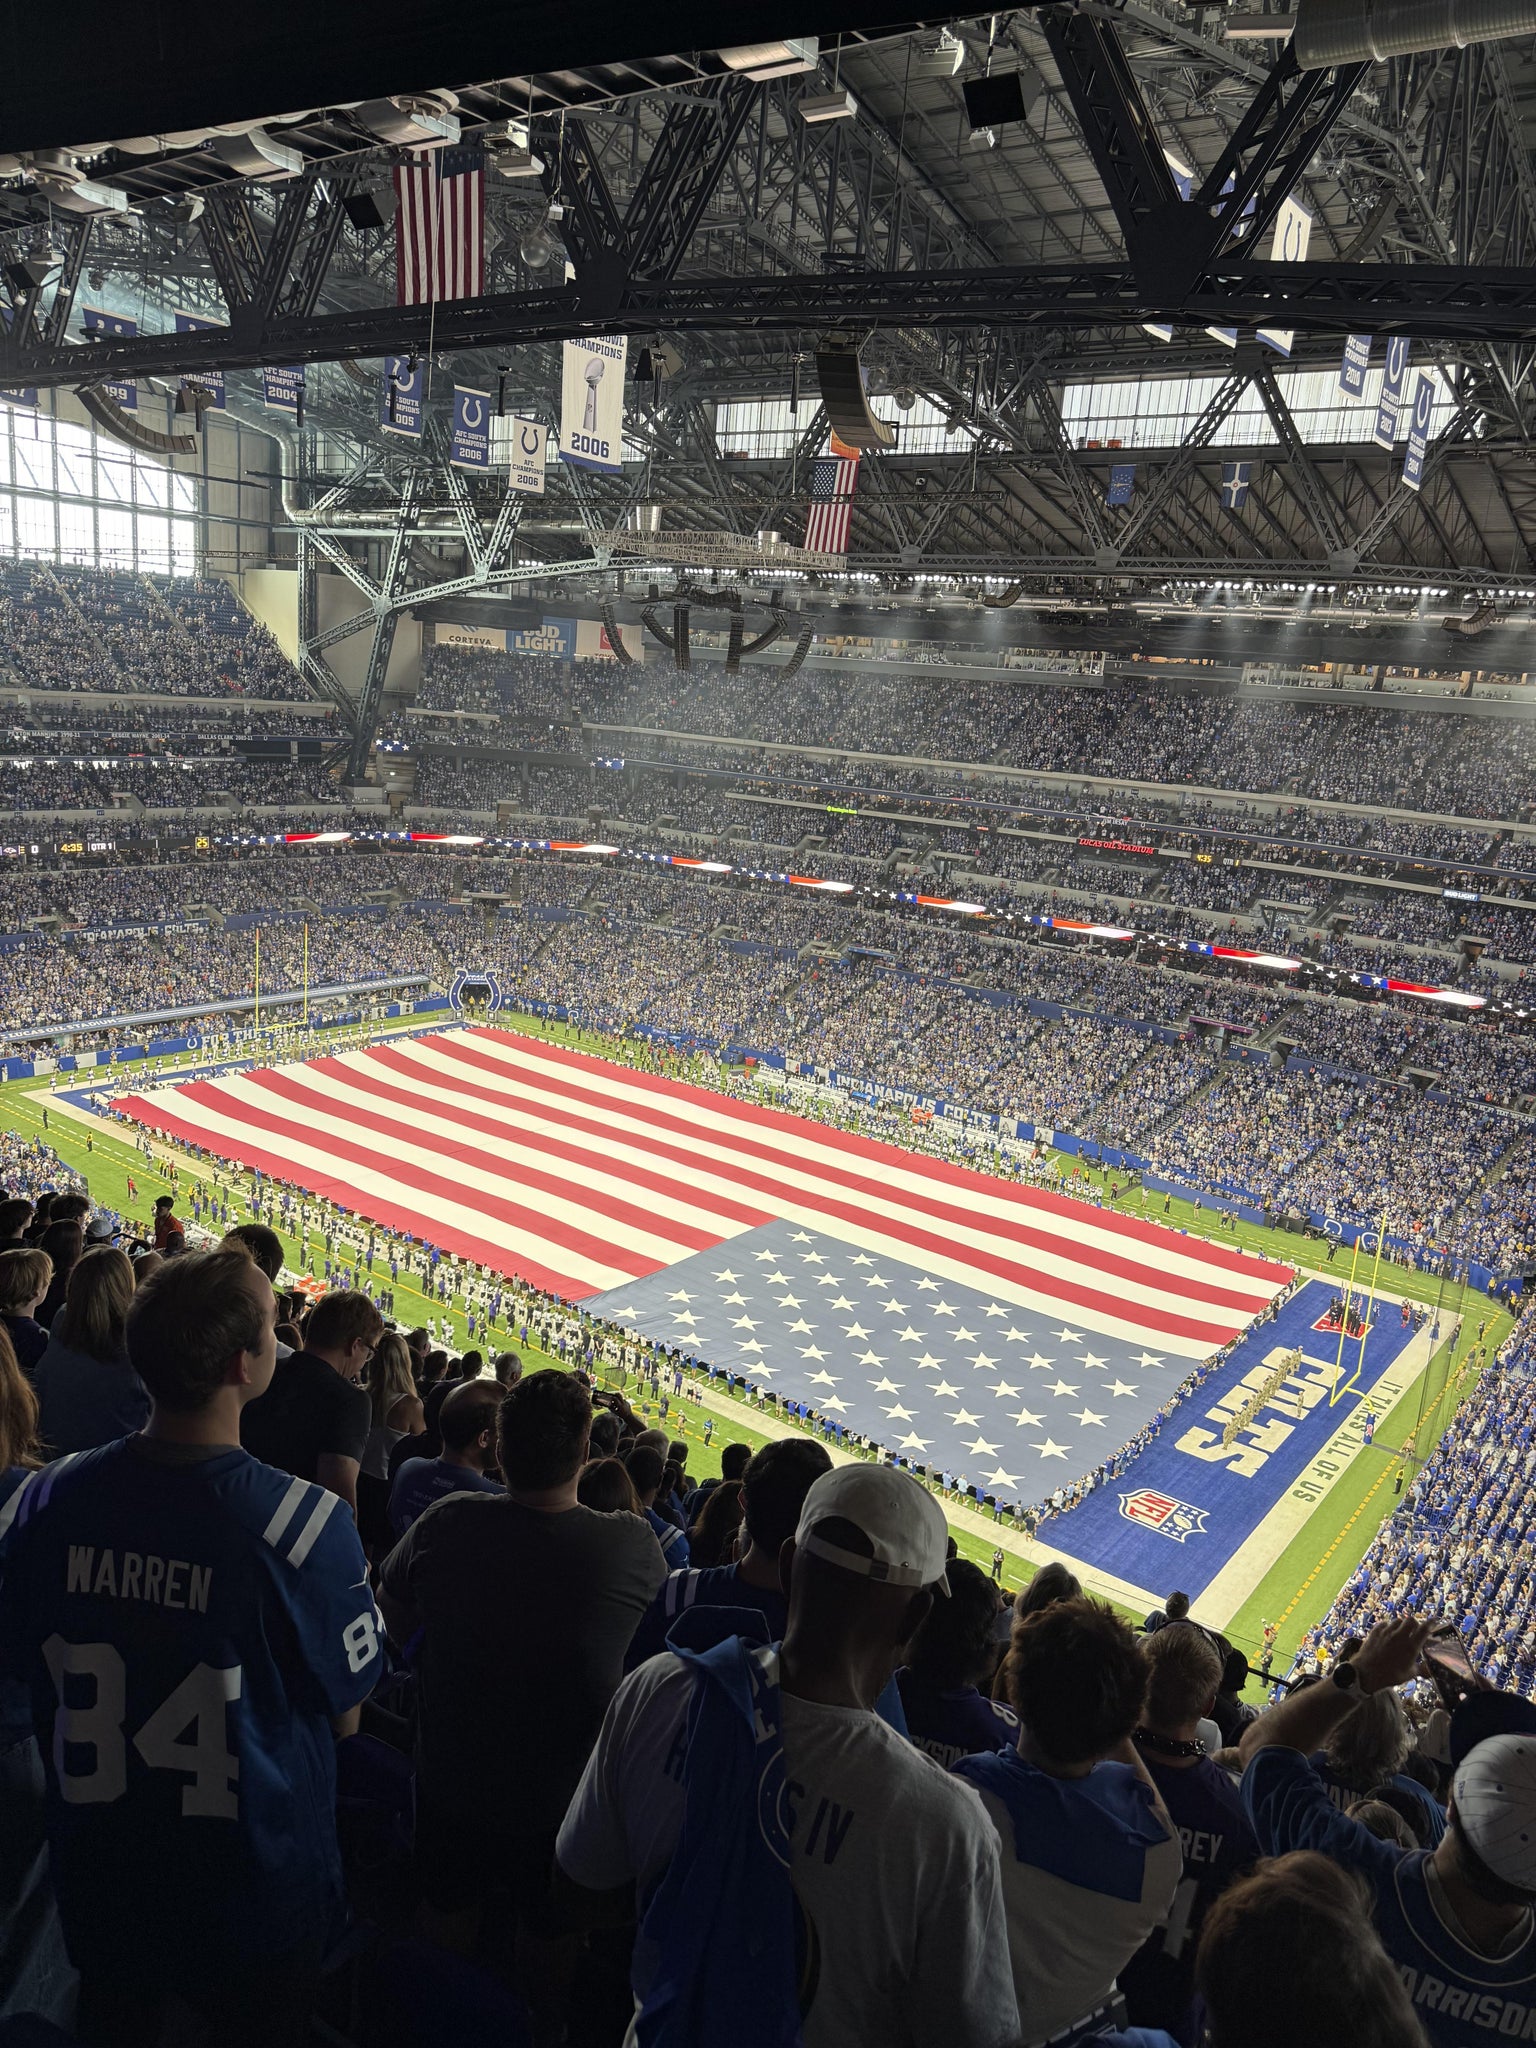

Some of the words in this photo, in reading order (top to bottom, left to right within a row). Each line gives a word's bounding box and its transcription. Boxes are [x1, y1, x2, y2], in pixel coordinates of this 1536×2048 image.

[569, 338, 623, 360] CHAMPIONS
[278, 369, 303, 380] SOUTH
[268, 386, 298, 401] 2004
[395, 413, 415, 427] 005
[454, 436, 488, 449] CHAMPIONS
[571, 431, 610, 459] 2006
[460, 447, 482, 460] 2006
[512, 463, 544, 476] CHAMPIONS
[524, 459, 535, 467] AFC
[517, 474, 539, 487] 2006
[523, 624, 560, 639] BUD
[449, 635, 492, 646] CORTEVA
[515, 636, 567, 653] LIGHT
[61, 843, 83, 852] 4:35
[91, 843, 106, 851] QTR
[197, 838, 208, 848] 25
[1079, 838, 1102, 849] LUCAS
[1103, 841, 1116, 850] OIL
[1117, 843, 1154, 855] STADIUM
[8, 1029, 46, 1039] LUCAS
[46, 1025, 67, 1034] OIL
[67, 1018, 117, 1032] STADIUM
[836, 1074, 936, 1116] INDIANAPOLIS
[943, 1102, 992, 1130] COLTS
[1175, 1346, 1346, 1478] COLTS
[1326, 1432, 1363, 1457] ALL
[1312, 1459, 1340, 1481] OF
[1292, 1480, 1324, 1503] US
[1128, 1494, 1177, 1523] NFL
[66, 1543, 213, 1614] WARREN
[41, 1631, 243, 1822] 84
[1178, 1826, 1224, 1864] REY
[1400, 1963, 1536, 2043] ARRISON
